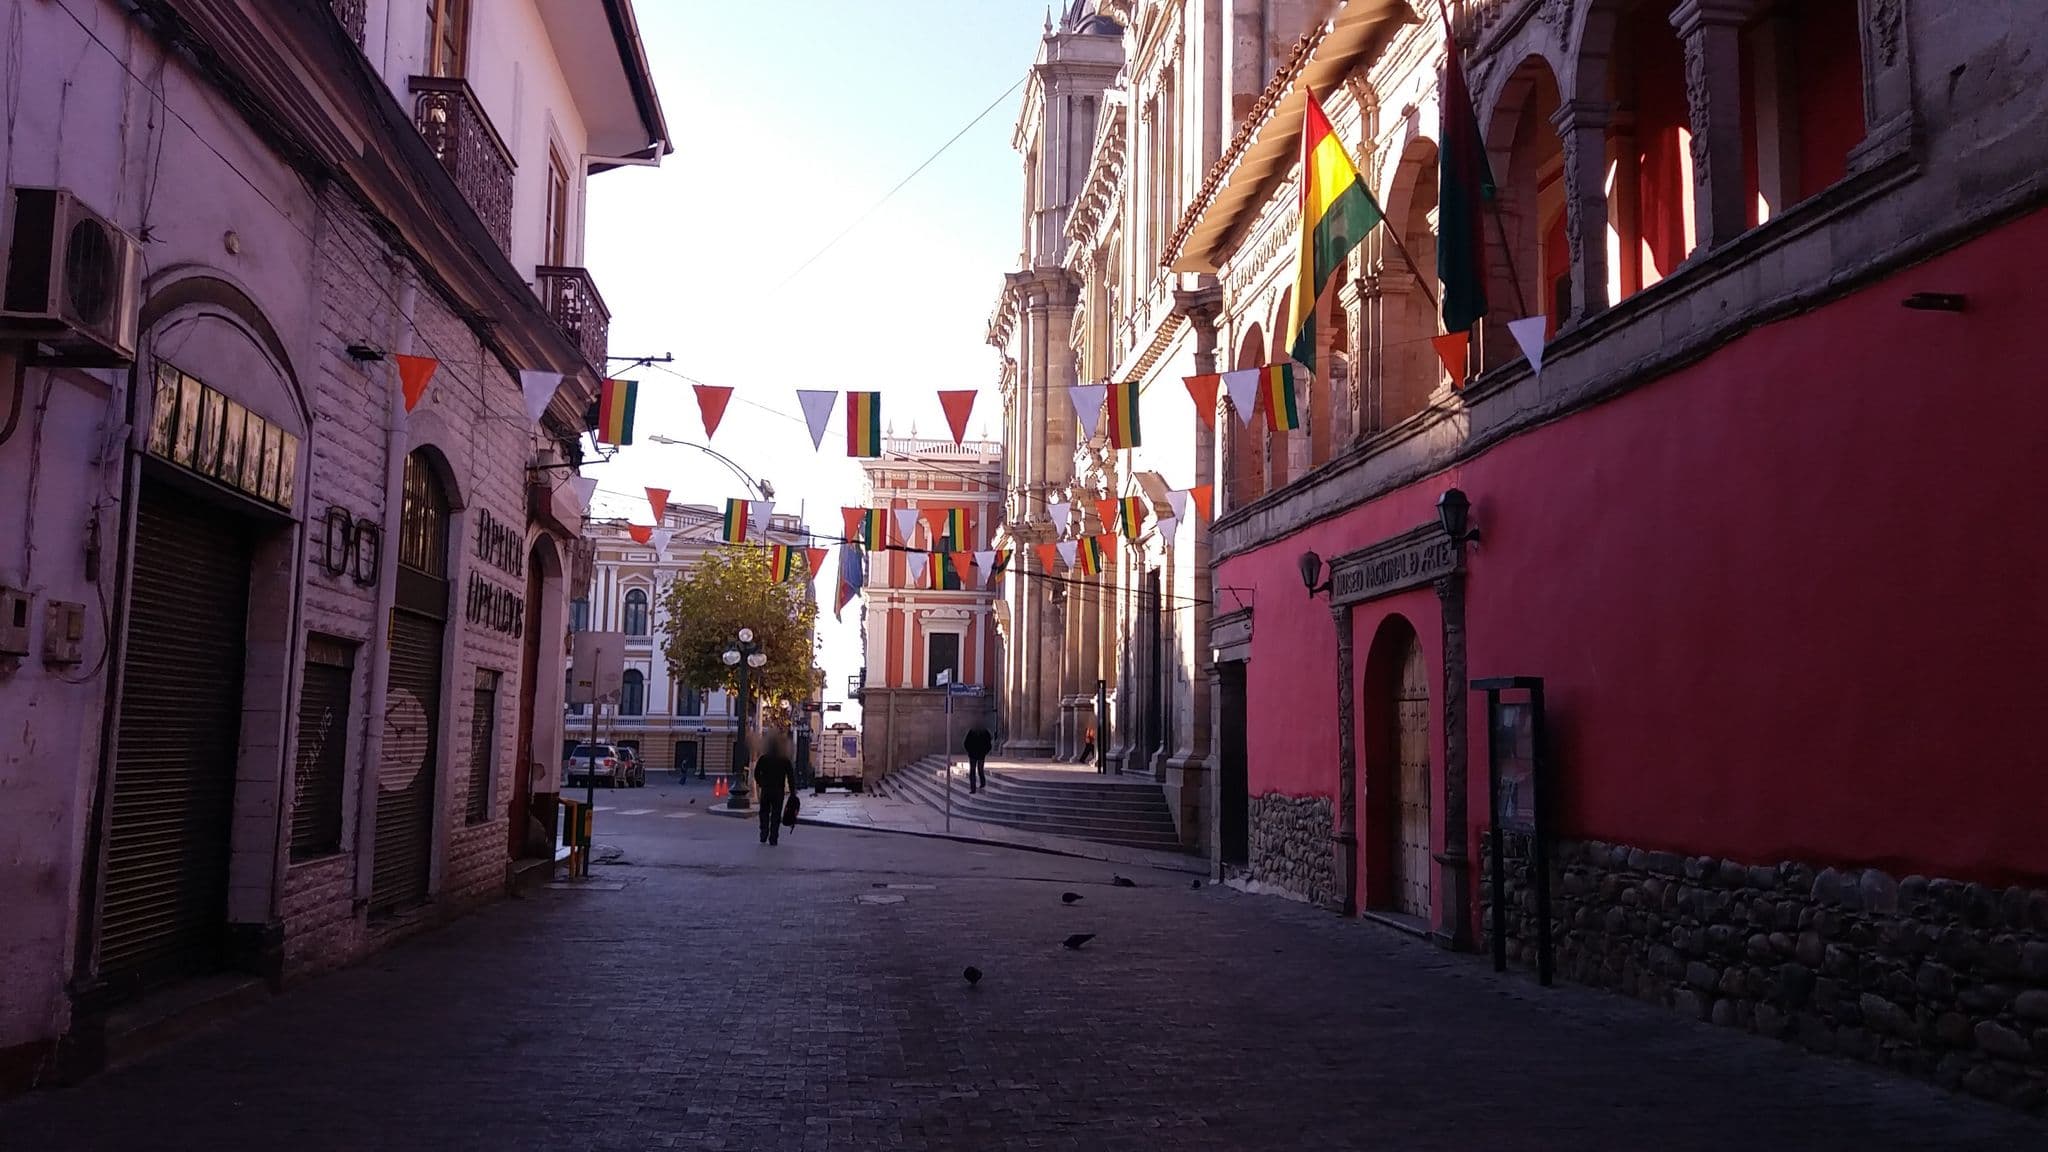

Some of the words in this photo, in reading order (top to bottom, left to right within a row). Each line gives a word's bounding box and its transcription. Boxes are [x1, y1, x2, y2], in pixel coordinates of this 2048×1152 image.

[1336, 569, 1364, 597] MUSEO
[1366, 552, 1409, 589] NACIONAL
[1421, 540, 1451, 572] ARTE
